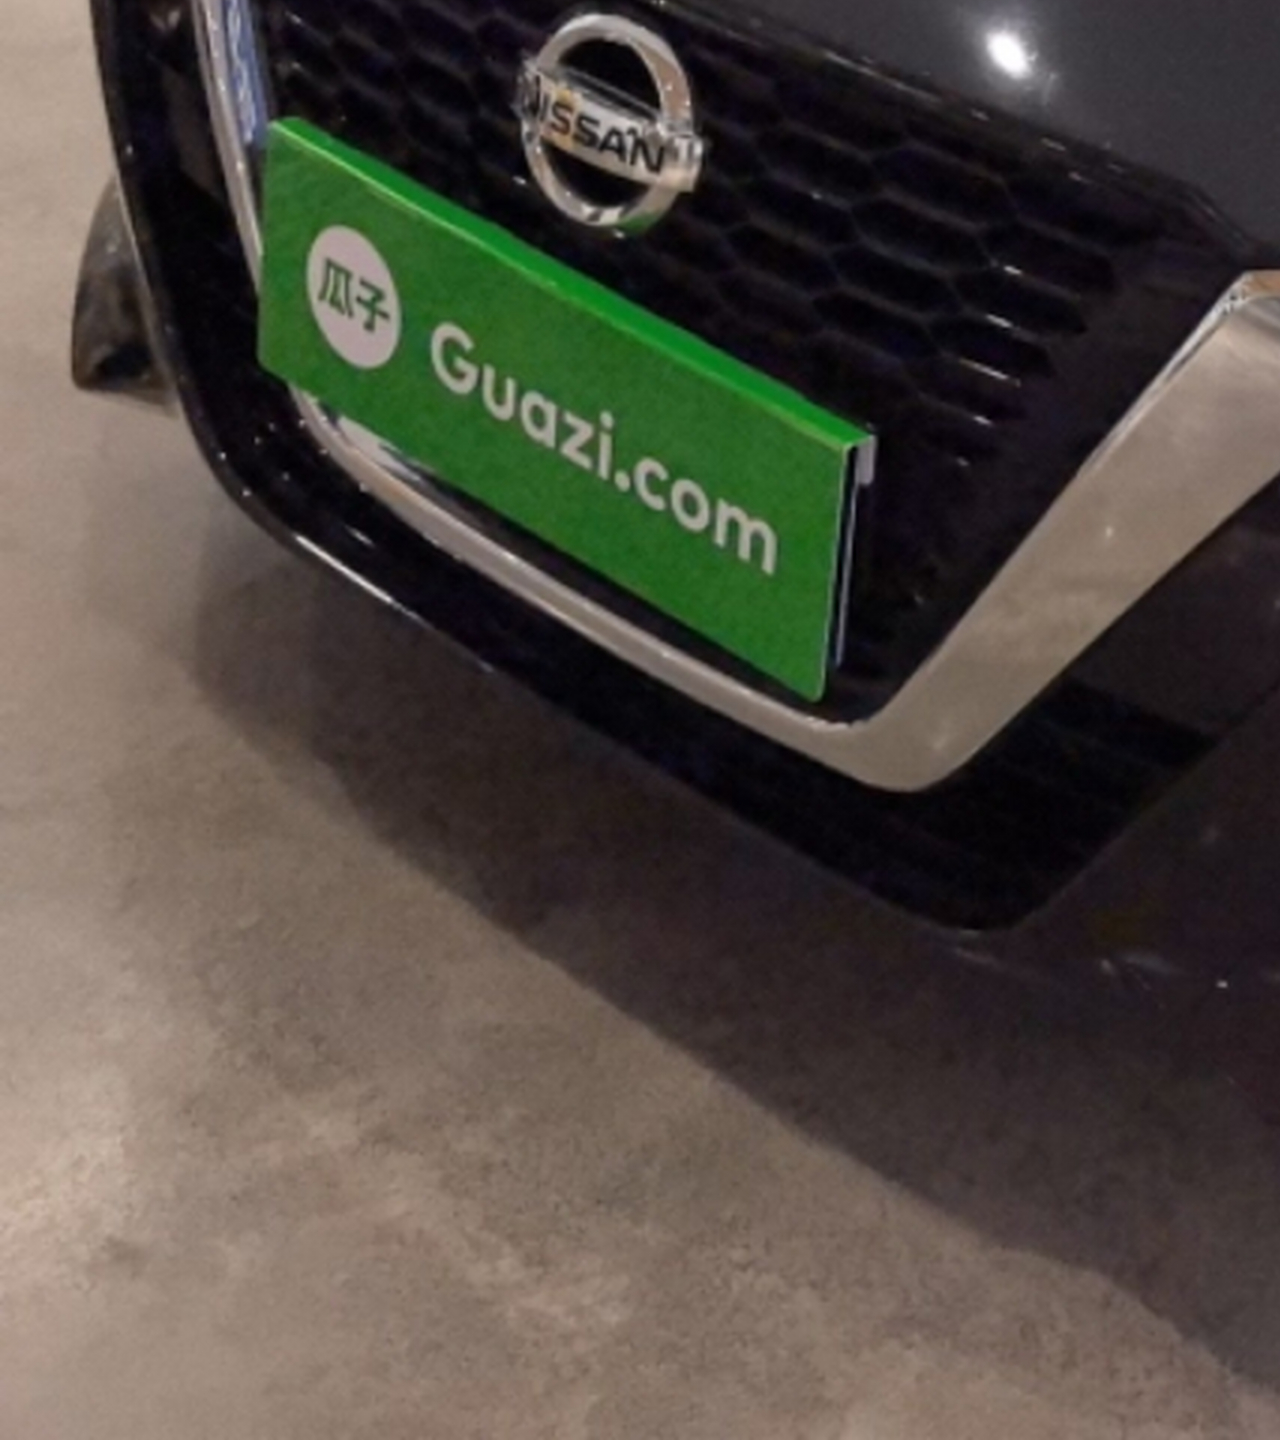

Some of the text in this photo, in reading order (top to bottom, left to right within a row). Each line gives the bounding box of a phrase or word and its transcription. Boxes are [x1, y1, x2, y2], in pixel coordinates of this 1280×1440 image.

[521, 67, 667, 174] NISSAN
[317, 260, 391, 333] 瓜子
[429, 321, 778, 577] Guazi.com
